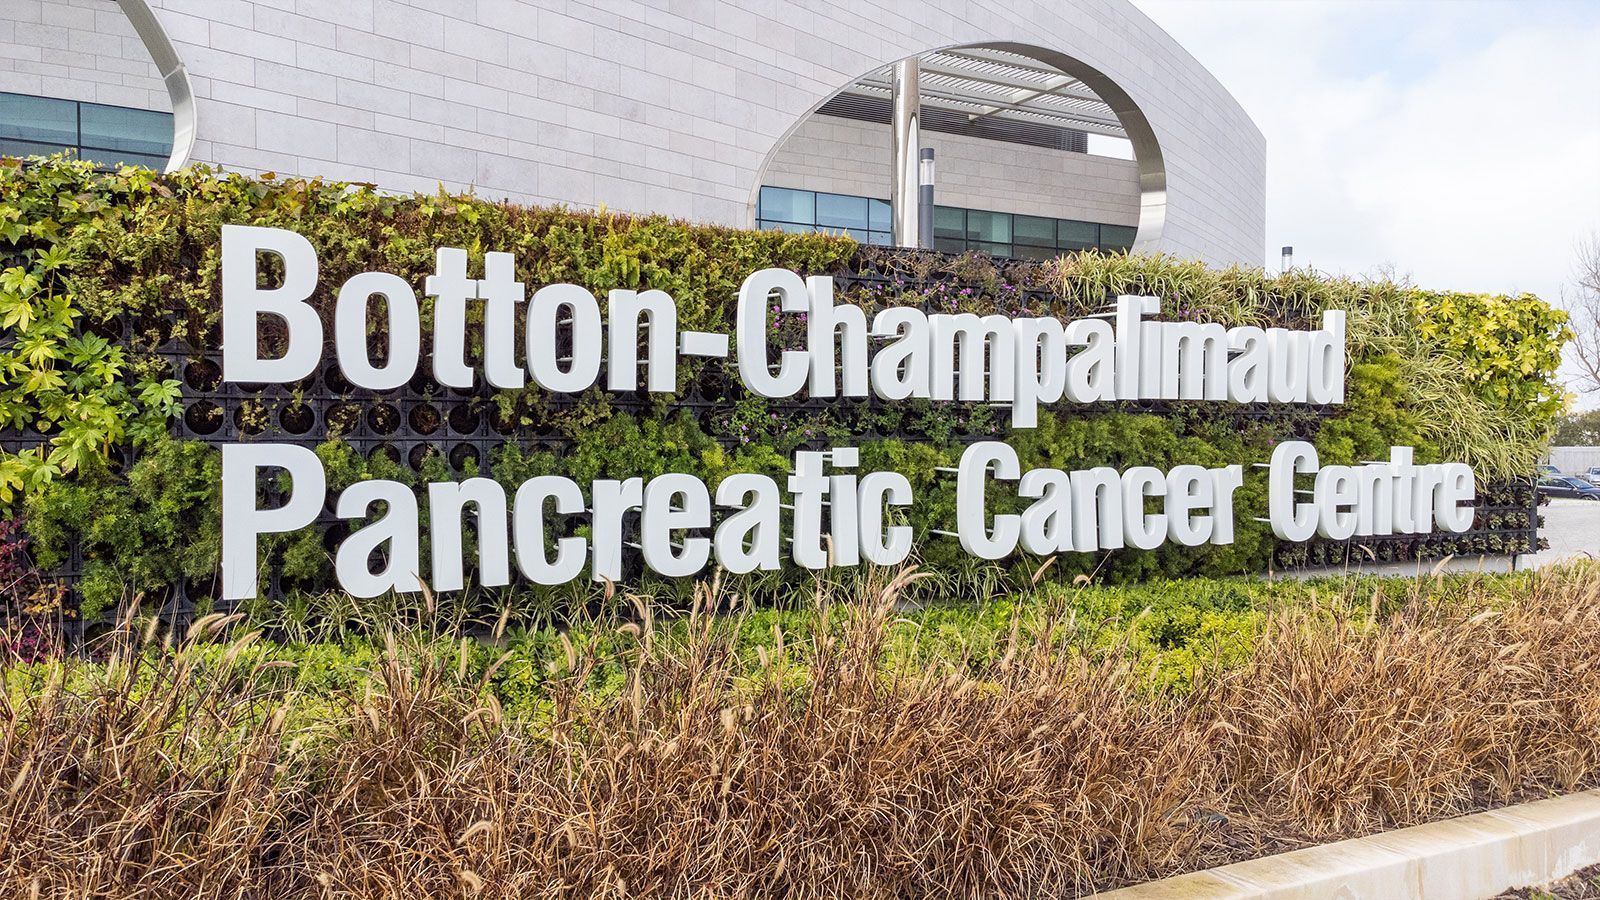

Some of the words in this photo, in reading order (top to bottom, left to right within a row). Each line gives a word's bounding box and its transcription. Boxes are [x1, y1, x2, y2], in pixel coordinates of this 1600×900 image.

[221, 224, 1346, 428] Botton-Champalimaud
[221, 443, 913, 600] Pancreatic
[957, 441, 1243, 560] Cancer
[1269, 440, 1475, 542] Centre
